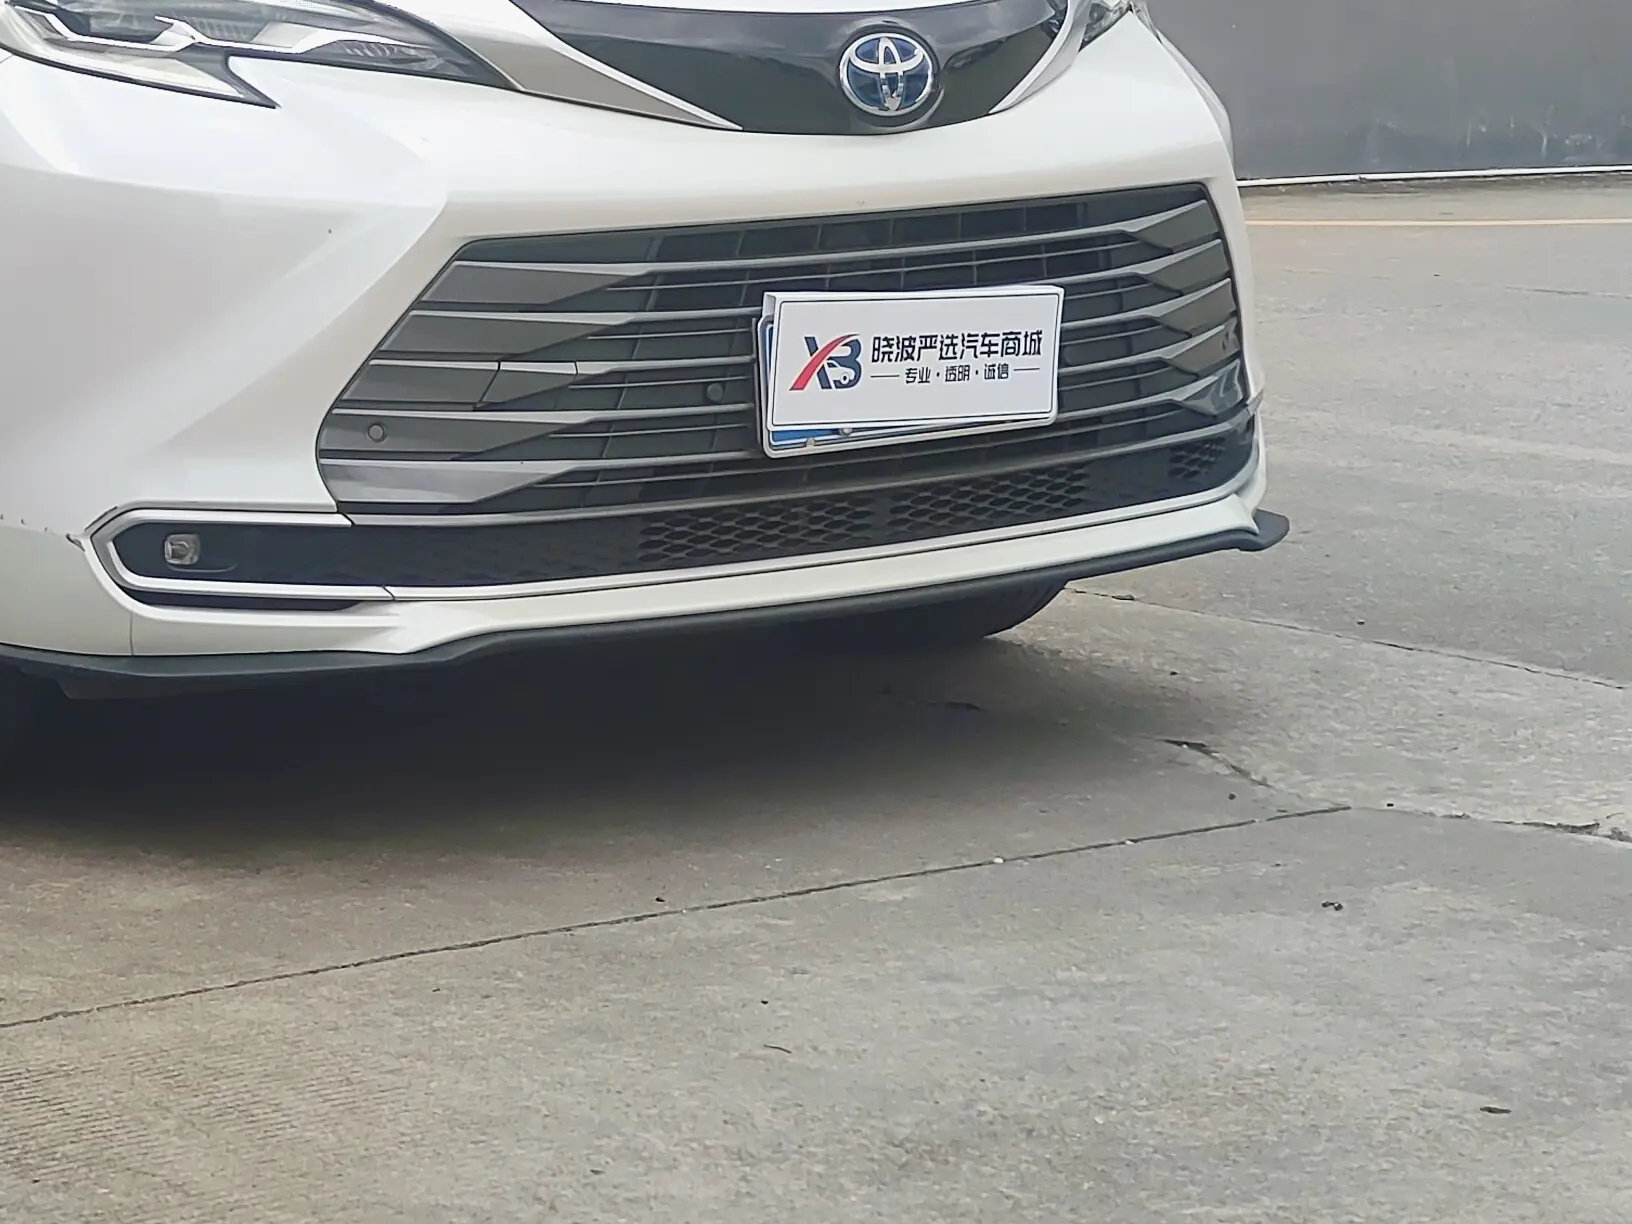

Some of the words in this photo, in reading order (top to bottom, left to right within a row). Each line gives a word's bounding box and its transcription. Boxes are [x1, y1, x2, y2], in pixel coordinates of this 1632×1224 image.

[871, 330, 1043, 363] 晓波严选汽车商城
